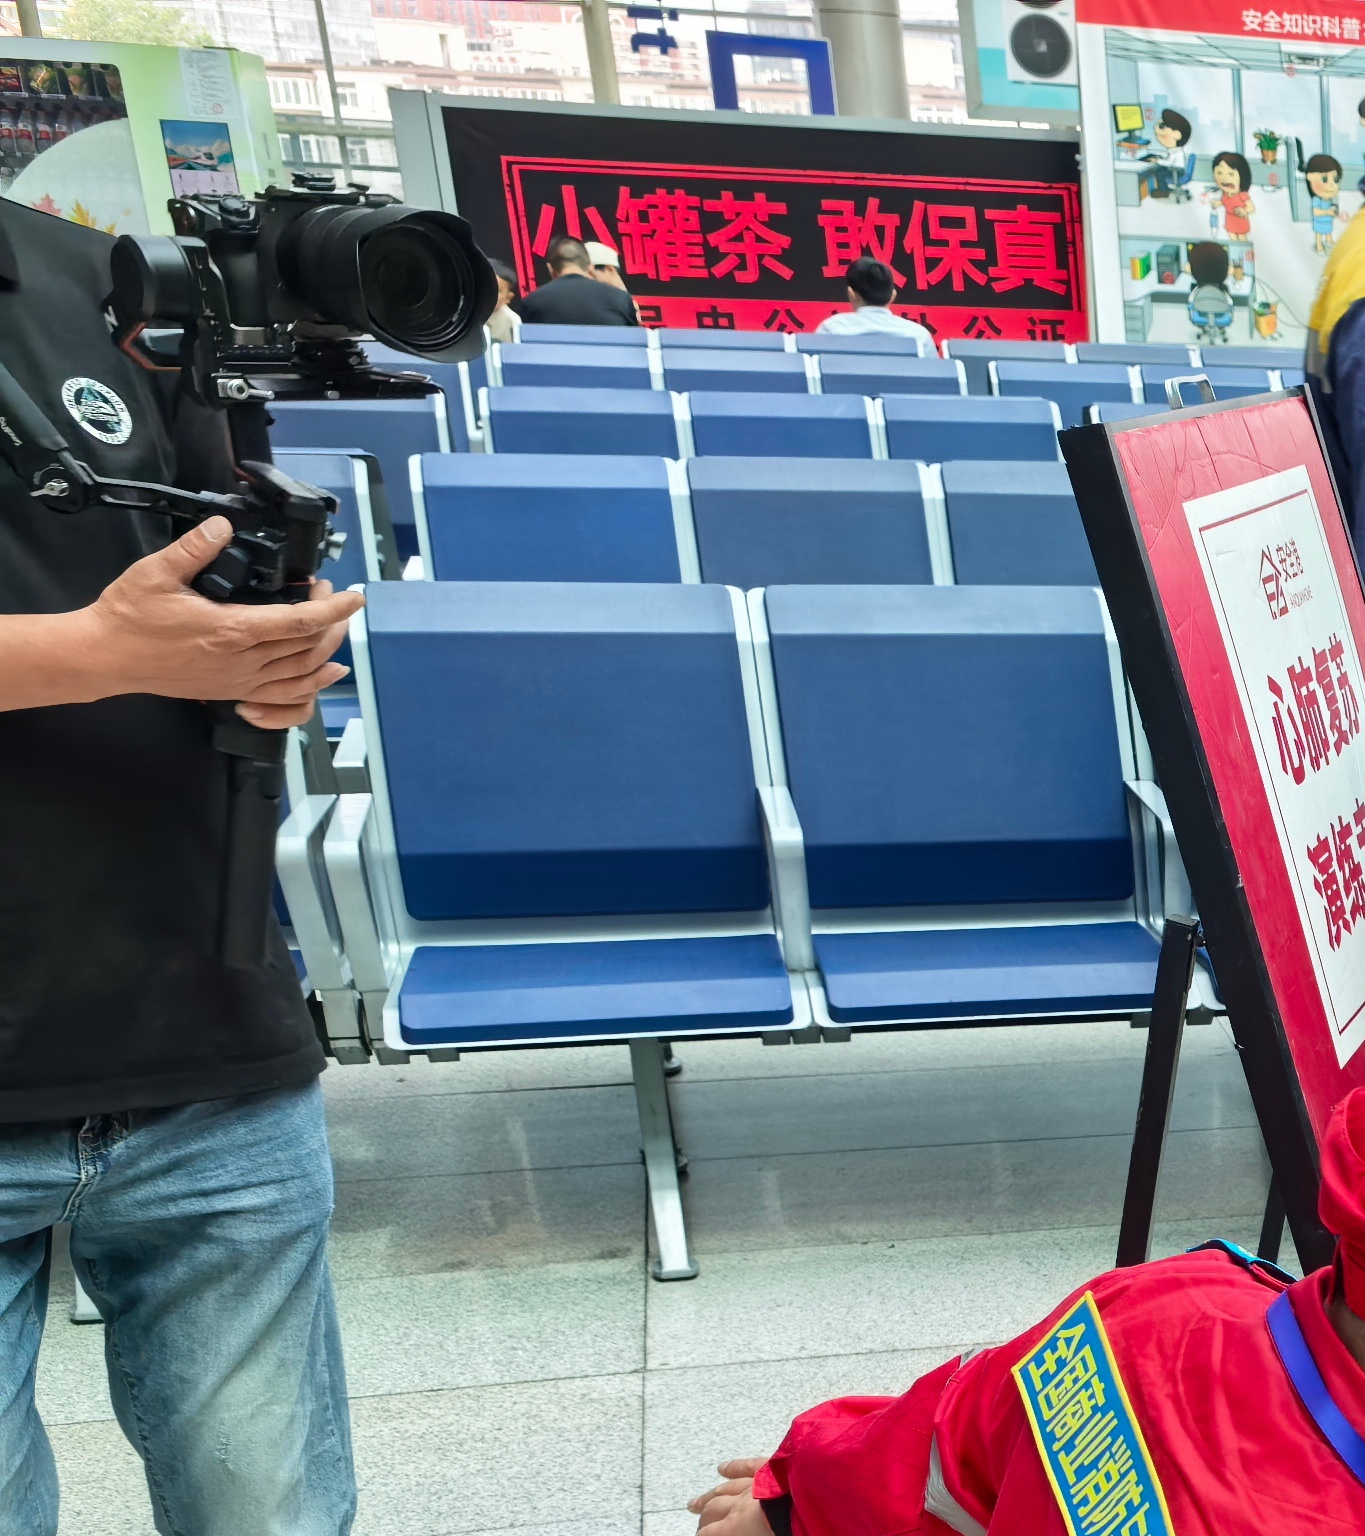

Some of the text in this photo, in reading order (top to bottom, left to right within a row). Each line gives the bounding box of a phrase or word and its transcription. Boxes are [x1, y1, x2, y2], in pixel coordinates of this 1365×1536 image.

[531, 184, 1068, 295] 小罐茶 敢保真
[1267, 636, 1362, 786] 心肺复苏
